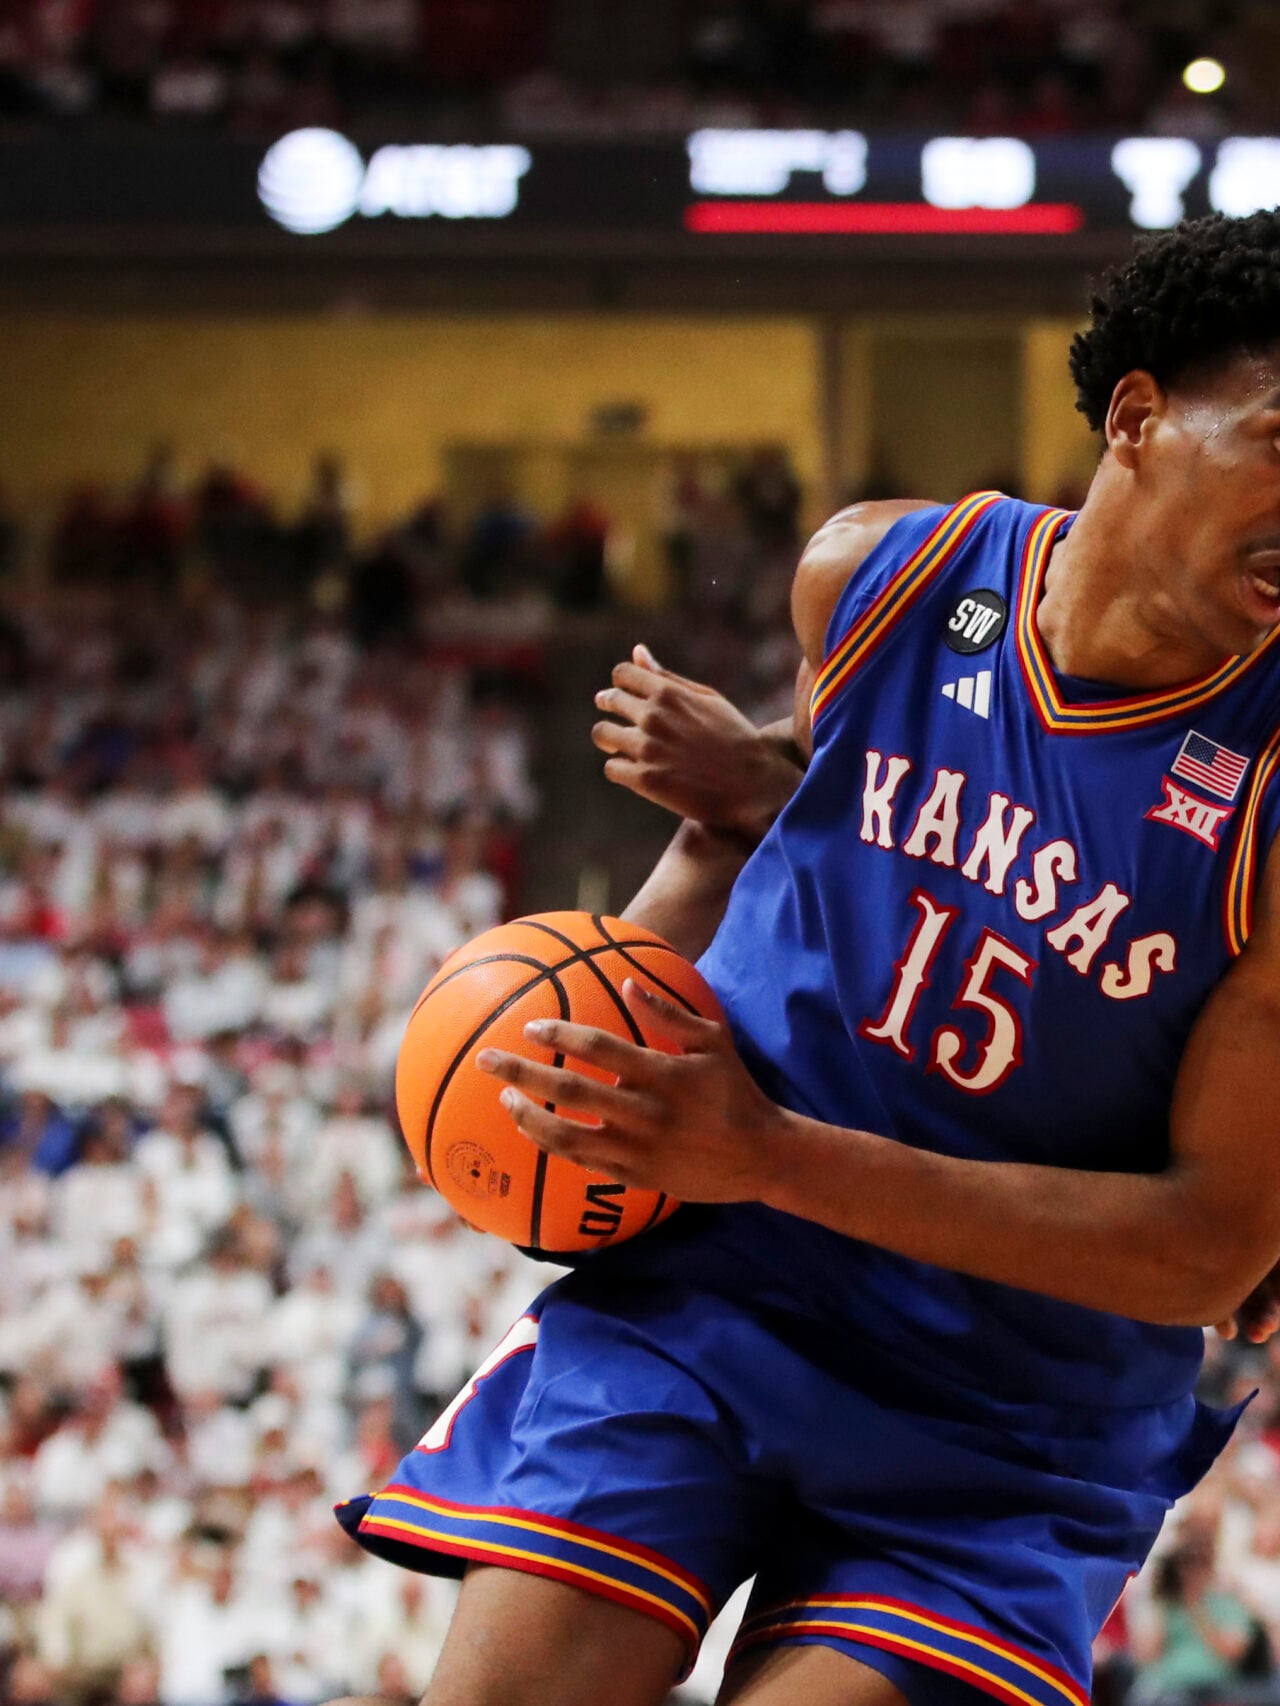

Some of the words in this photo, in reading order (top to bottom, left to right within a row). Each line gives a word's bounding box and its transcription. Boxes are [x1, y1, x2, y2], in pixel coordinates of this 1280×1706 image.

[948, 598, 1001, 645] SW
[1147, 778, 1232, 850] XII
[859, 749, 1178, 1001] KANSAS
[857, 887, 1040, 1096] 15
[578, 1183, 627, 1237] VO
